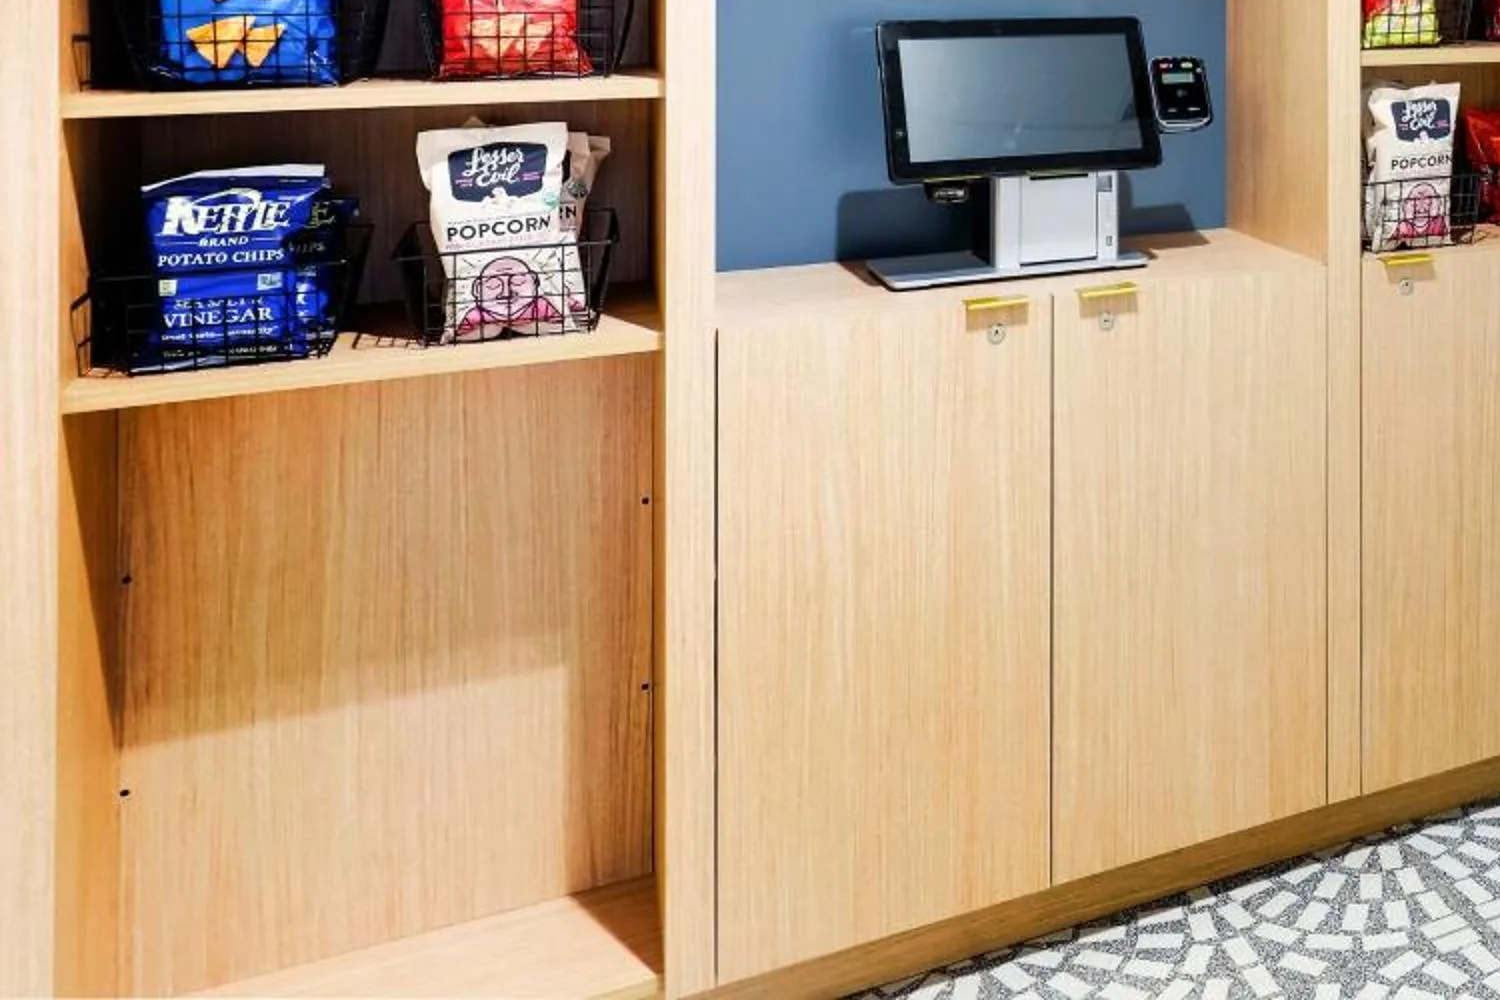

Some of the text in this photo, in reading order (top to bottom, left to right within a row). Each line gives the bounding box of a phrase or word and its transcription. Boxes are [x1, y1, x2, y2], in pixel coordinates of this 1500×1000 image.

[1391, 154, 1453, 170] POPCORN
[447, 215, 551, 242] POPCORN
[157, 248, 285, 267] POTATO CHIPS
[163, 307, 275, 329] VINEGAR
